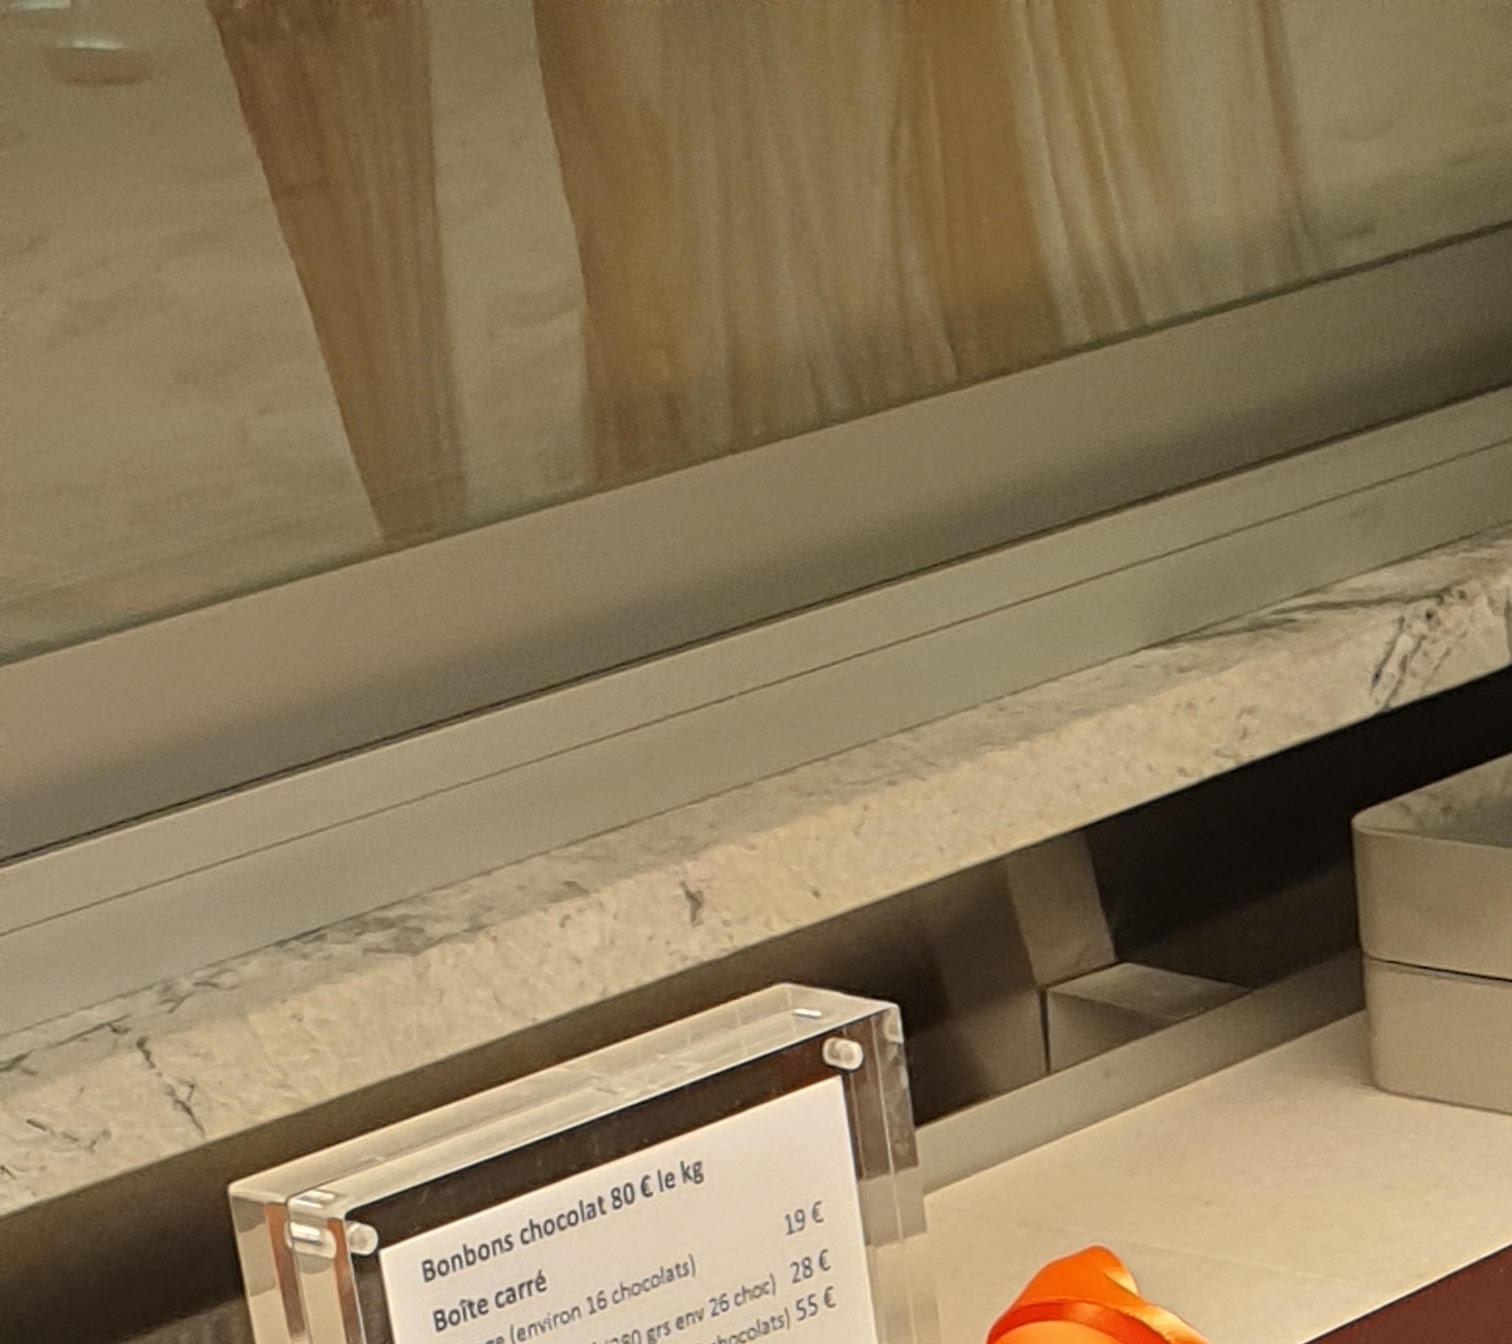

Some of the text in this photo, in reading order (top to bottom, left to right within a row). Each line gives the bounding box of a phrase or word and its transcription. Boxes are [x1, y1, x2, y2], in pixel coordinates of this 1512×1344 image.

[420, 1159, 705, 1283] Bonbons chocolat 80 € le kg
[585, 1289, 608, 1315] 16
[610, 1252, 697, 1305] chocolats)
[783, 1207, 806, 1236] 19
[810, 1199, 825, 1224] €
[431, 1268, 548, 1333] Boîte carré
[674, 1306, 705, 1331] env
[707, 1291, 730, 1318] 26
[732, 1271, 777, 1308] choc)
[788, 1255, 814, 1284] 28
[817, 1247, 831, 1272] €
[794, 1292, 819, 1322] 55
[822, 1284, 837, 1309] €
